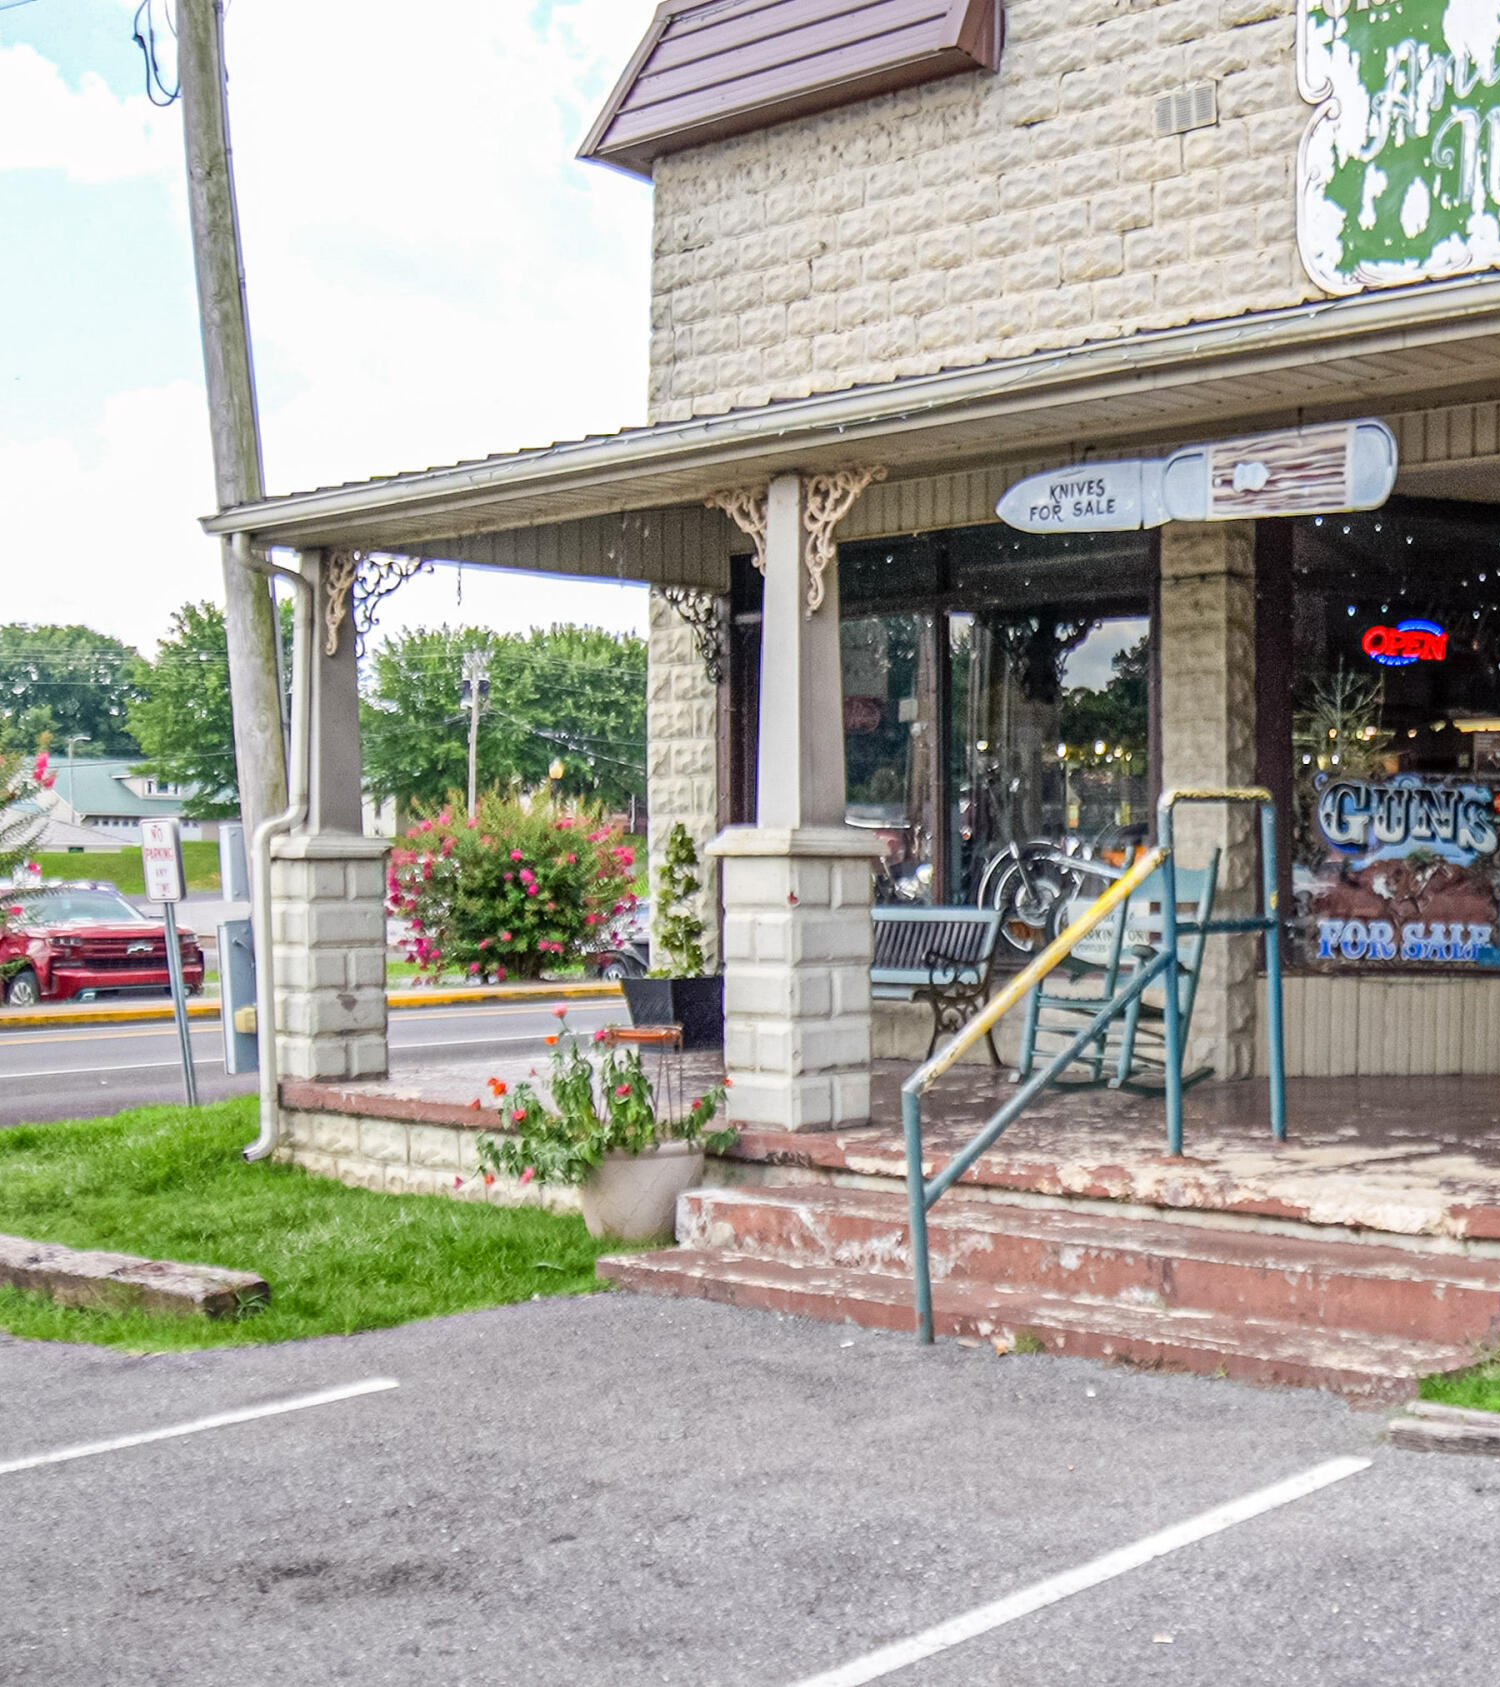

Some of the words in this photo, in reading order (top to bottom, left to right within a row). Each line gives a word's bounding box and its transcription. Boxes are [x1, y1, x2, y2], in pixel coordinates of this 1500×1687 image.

[1049, 477, 1106, 503] KNIVES
[1029, 505, 1064, 523] FOR
[1072, 498, 1117, 517] SALE
[1361, 625, 1449, 661] OPEN
[1317, 782, 1498, 854] GUNS
[1316, 918, 1397, 960] FOR
[1402, 921, 1493, 962] SALE
